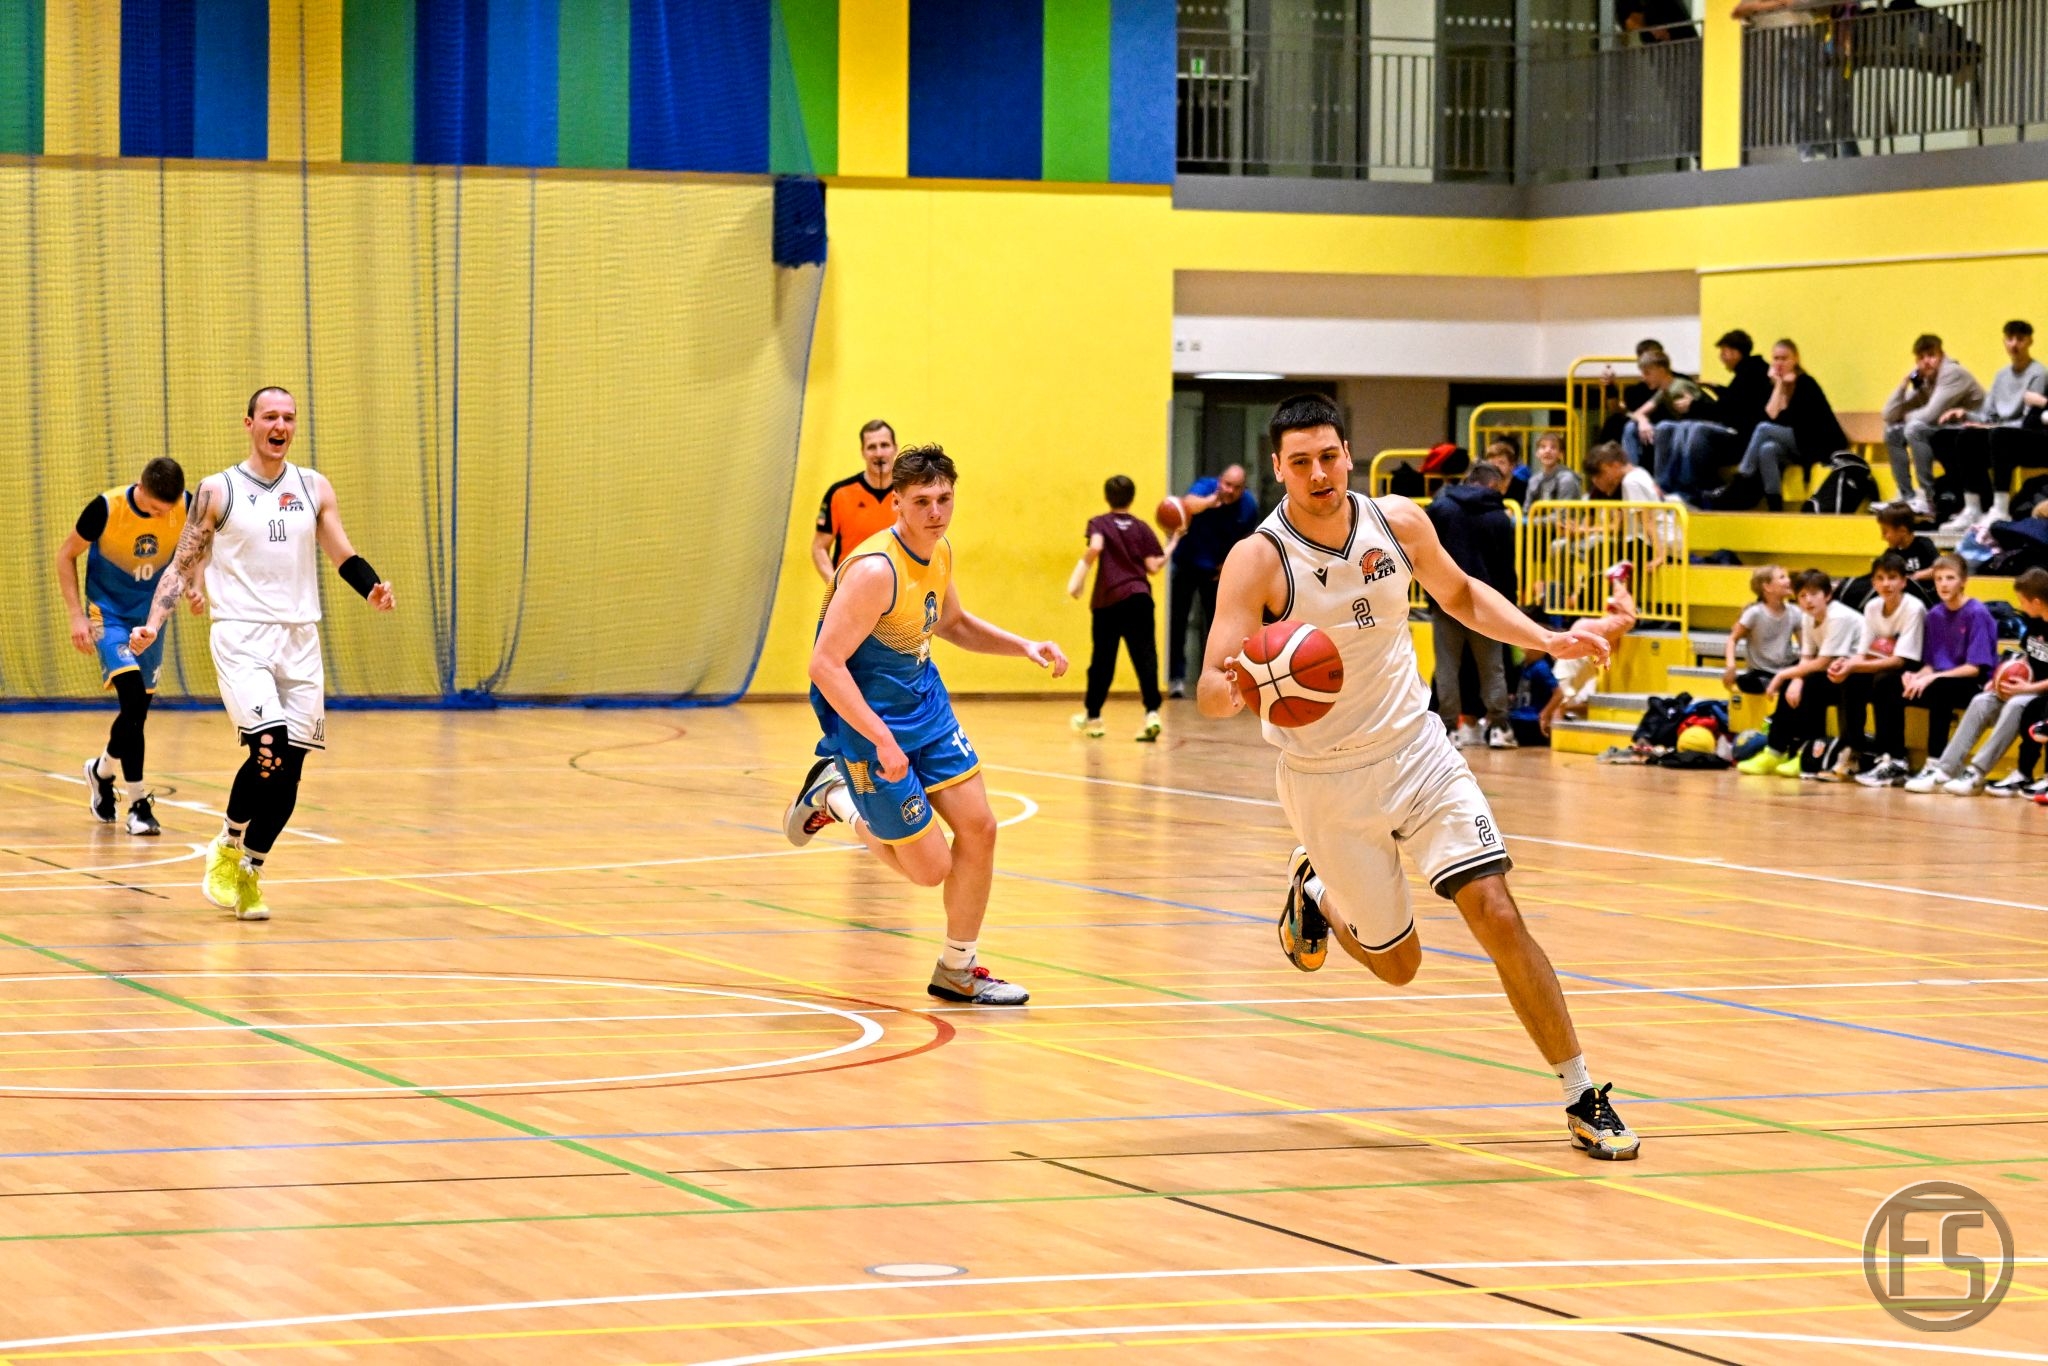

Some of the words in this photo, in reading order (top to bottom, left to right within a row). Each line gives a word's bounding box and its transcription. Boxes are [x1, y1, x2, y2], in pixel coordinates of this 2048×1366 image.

[268, 519, 287, 542] 11
[133, 564, 154, 582] 10
[1363, 564, 1397, 585] PLZEN
[1352, 597, 1376, 630] 2
[1474, 814, 1497, 848] 2
